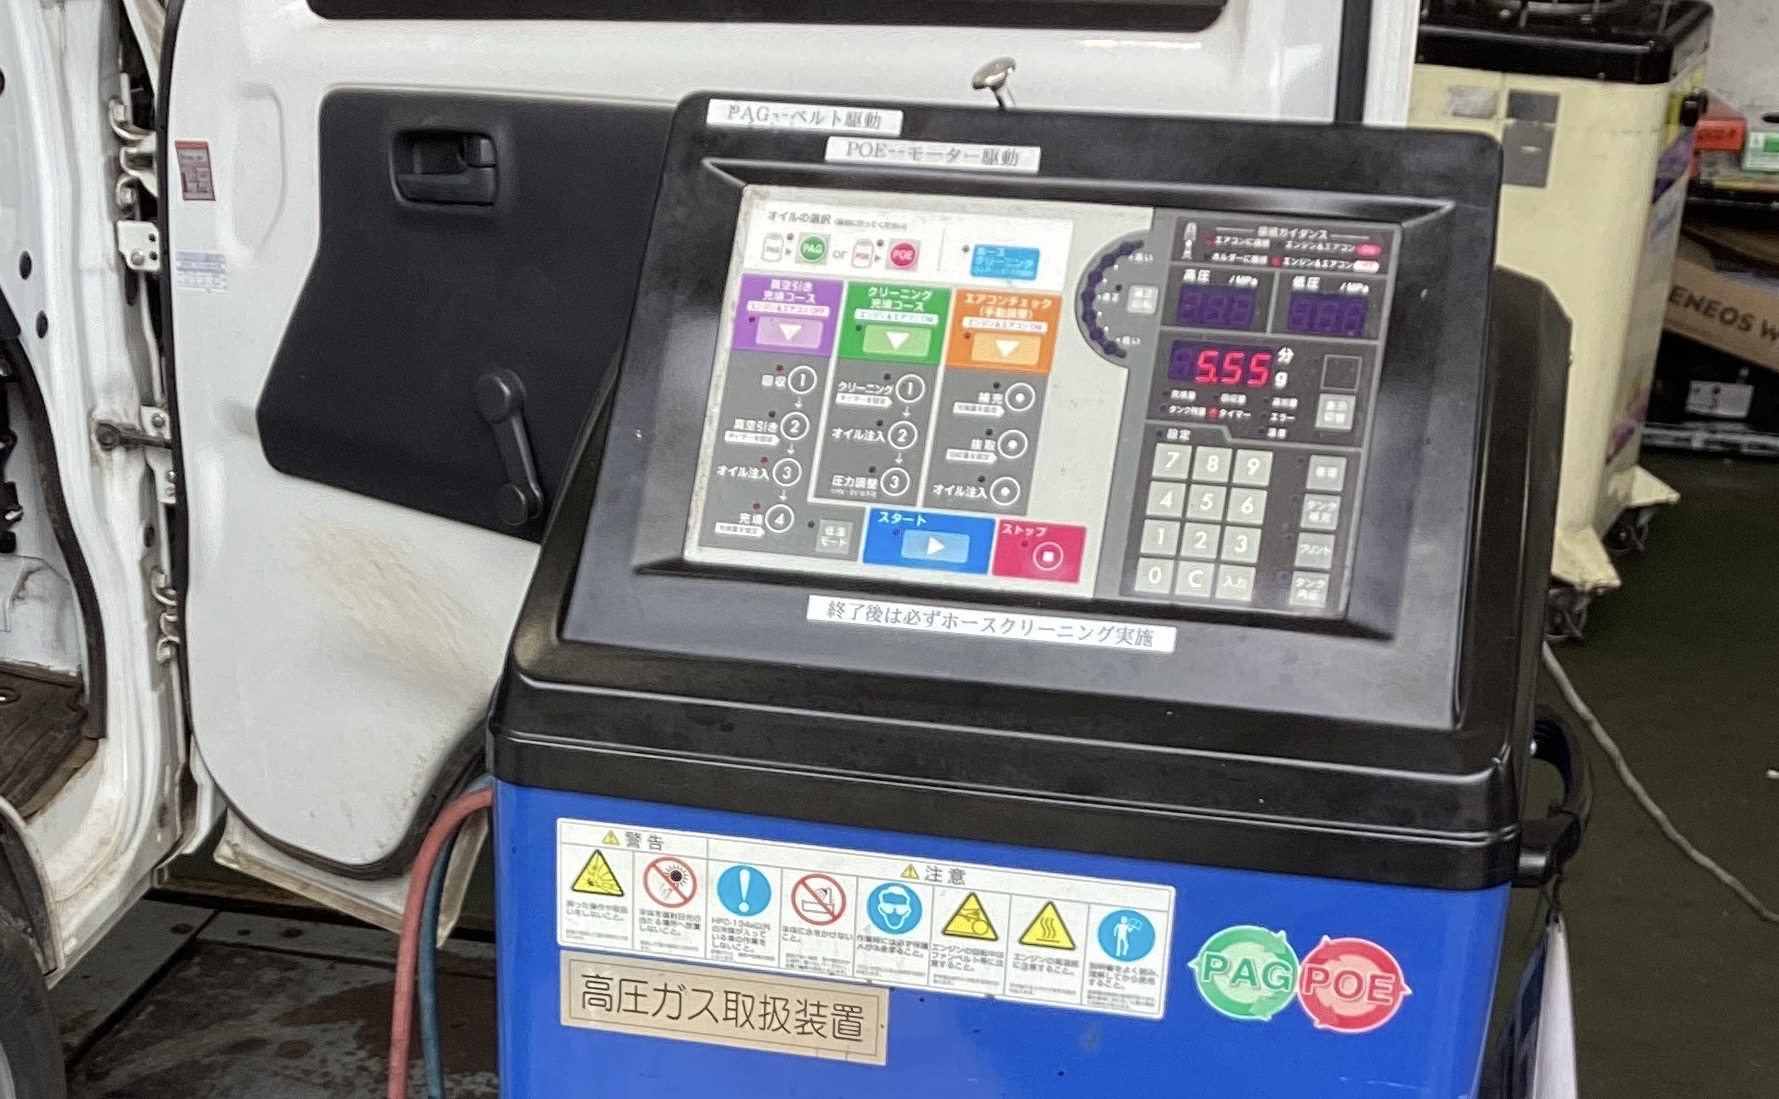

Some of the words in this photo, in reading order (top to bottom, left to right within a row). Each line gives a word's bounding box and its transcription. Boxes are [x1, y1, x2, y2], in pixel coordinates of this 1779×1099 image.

[801, 241, 825, 254] PAG
[832, 249, 848, 259] or
[891, 248, 915, 261] POE
[867, 286, 933, 301] クリーニング
[964, 293, 1052, 309] エアコンチェック
[1668, 283, 1755, 333] ENEOS
[838, 381, 894, 396] クリーニング
[1274, 371, 1288, 389] g
[734, 418, 779, 433] 真空引き
[1269, 412, 1296, 424] エラー
[832, 427, 886, 443] オイル注入
[1164, 451, 1180, 469] 7
[1206, 454, 1219, 473] 8
[1247, 458, 1261, 475] 9
[716, 464, 770, 481] オイル注入
[932, 484, 988, 499] オイル注入
[1159, 489, 1173, 506] 4
[1199, 493, 1214, 511] 5
[1240, 496, 1254, 514] 6
[877, 510, 927, 527] スタート
[1001, 522, 1049, 537] ストップ
[1157, 527, 1164, 545] 1
[1195, 531, 1208, 549] 2
[1234, 535, 1248, 552] 3
[1148, 566, 1162, 584] 0
[1188, 569, 1204, 588] C
[826, 599, 1154, 648] 終了後は必ずホースクリーニング実施
[624, 831, 664, 852] 警告
[924, 865, 966, 885] 注意
[1199, 951, 1294, 993] PAG
[1300, 963, 1397, 1006] POE
[581, 973, 864, 1042] 高圧ガス取扱装置
